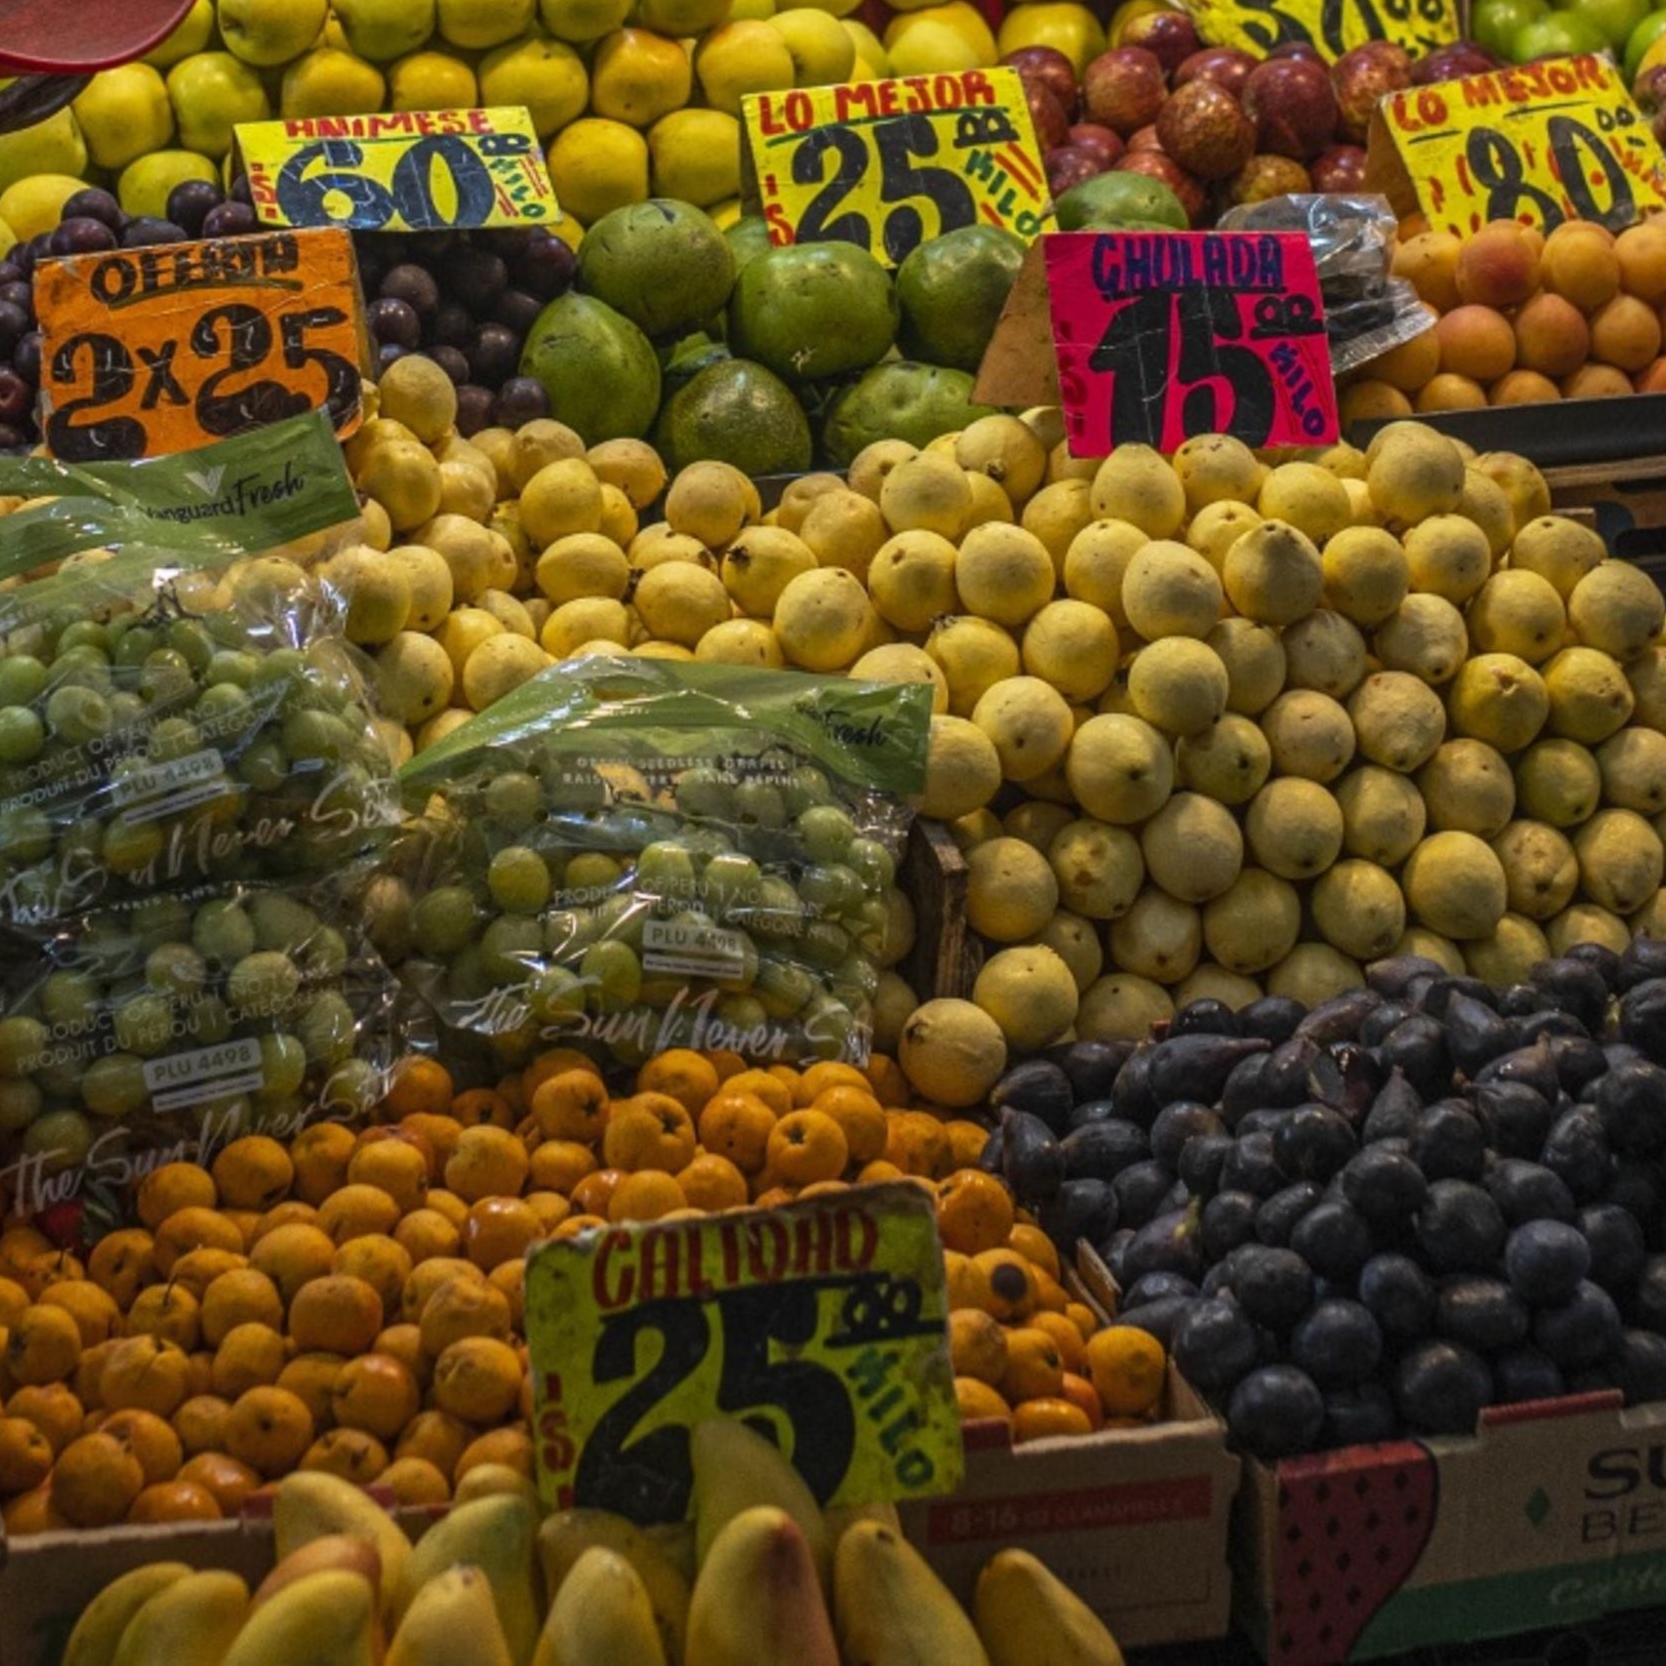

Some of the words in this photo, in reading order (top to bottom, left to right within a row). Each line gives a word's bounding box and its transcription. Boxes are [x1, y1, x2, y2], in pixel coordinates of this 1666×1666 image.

[758, 92, 814, 137] LO
[833, 69, 997, 123] MEJOR
[1391, 90, 1449, 132] LO
[1460, 54, 1610, 109] MEJOR
[276, 133, 497, 229] 60
[790, 113, 978, 265] 25
[964, 148, 1042, 238] KILO
[1465, 115, 1637, 240] 80
[1091, 234, 1283, 290] CHULADA
[1087, 287, 1276, 452] 15
[233, 460, 305, 516] Fresh
[651, 927, 688, 946] PLU
[449, 982, 535, 1035] The
[538, 974, 653, 1044] Sun
[652, 985, 793, 1058] Never
[152, 1060, 193, 1082] PLU
[198, 1045, 253, 1072] 4498
[592, 1204, 880, 1310] CALIDAD
[574, 1284, 857, 1526] 25
[845, 1345, 934, 1490] KILO
